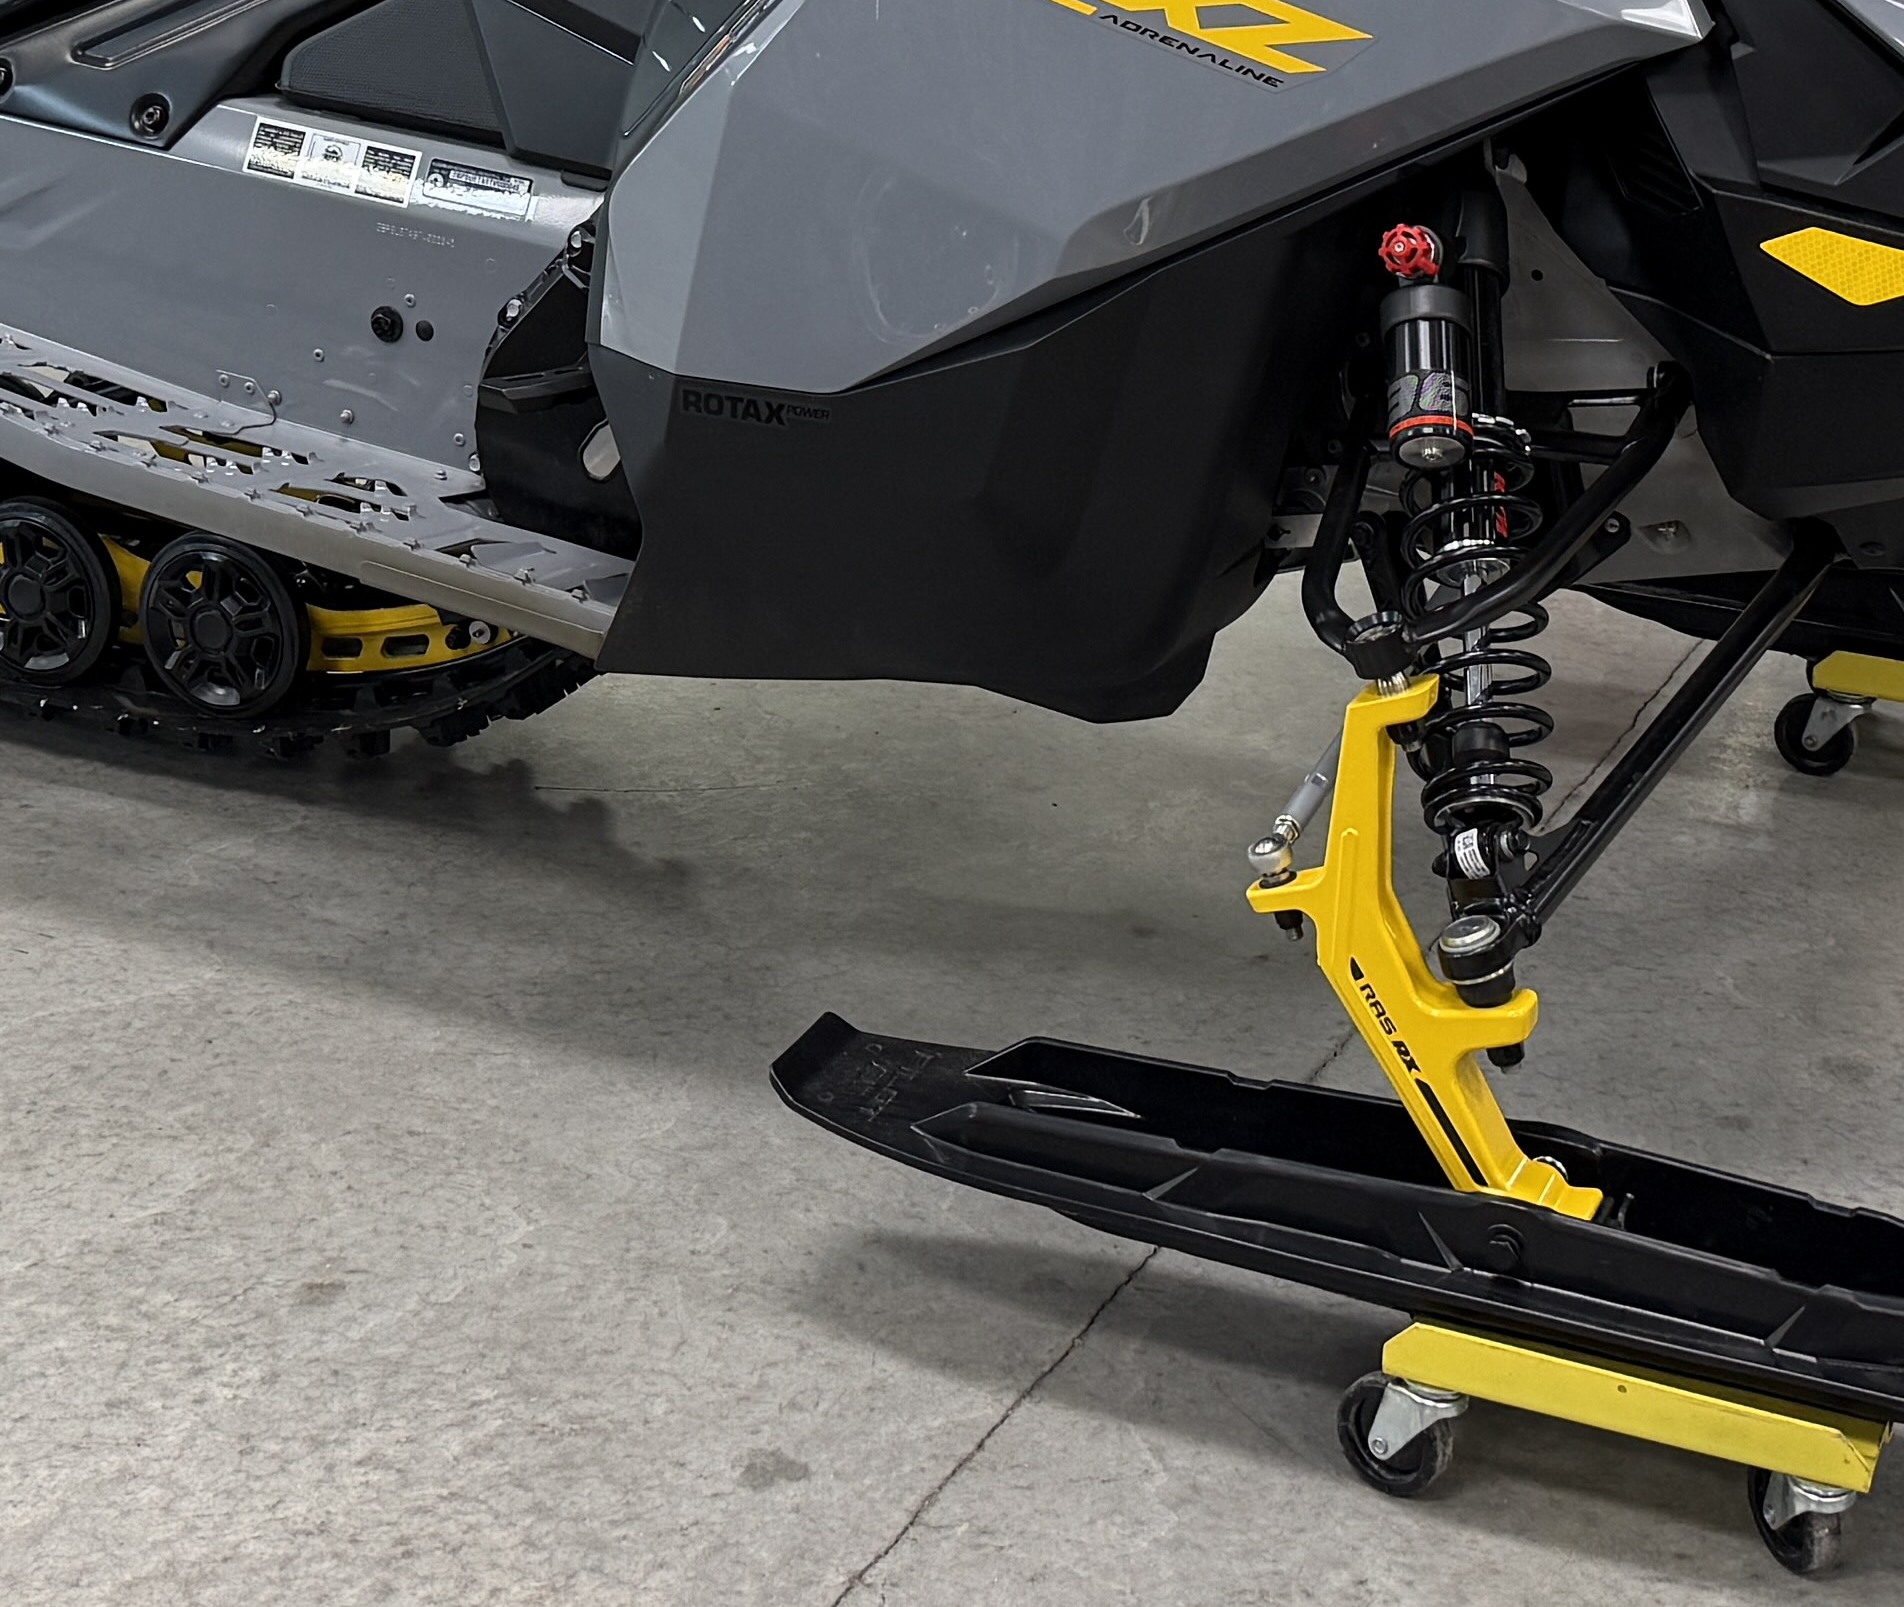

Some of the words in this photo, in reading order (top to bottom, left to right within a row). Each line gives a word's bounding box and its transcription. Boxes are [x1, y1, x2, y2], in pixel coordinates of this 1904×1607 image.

[1100, 13, 1285, 89] ADRENALINE
[682, 388, 786, 427] ROTAX
[1359, 983, 1397, 1035] RAS
[1392, 1040, 1421, 1073] RX
